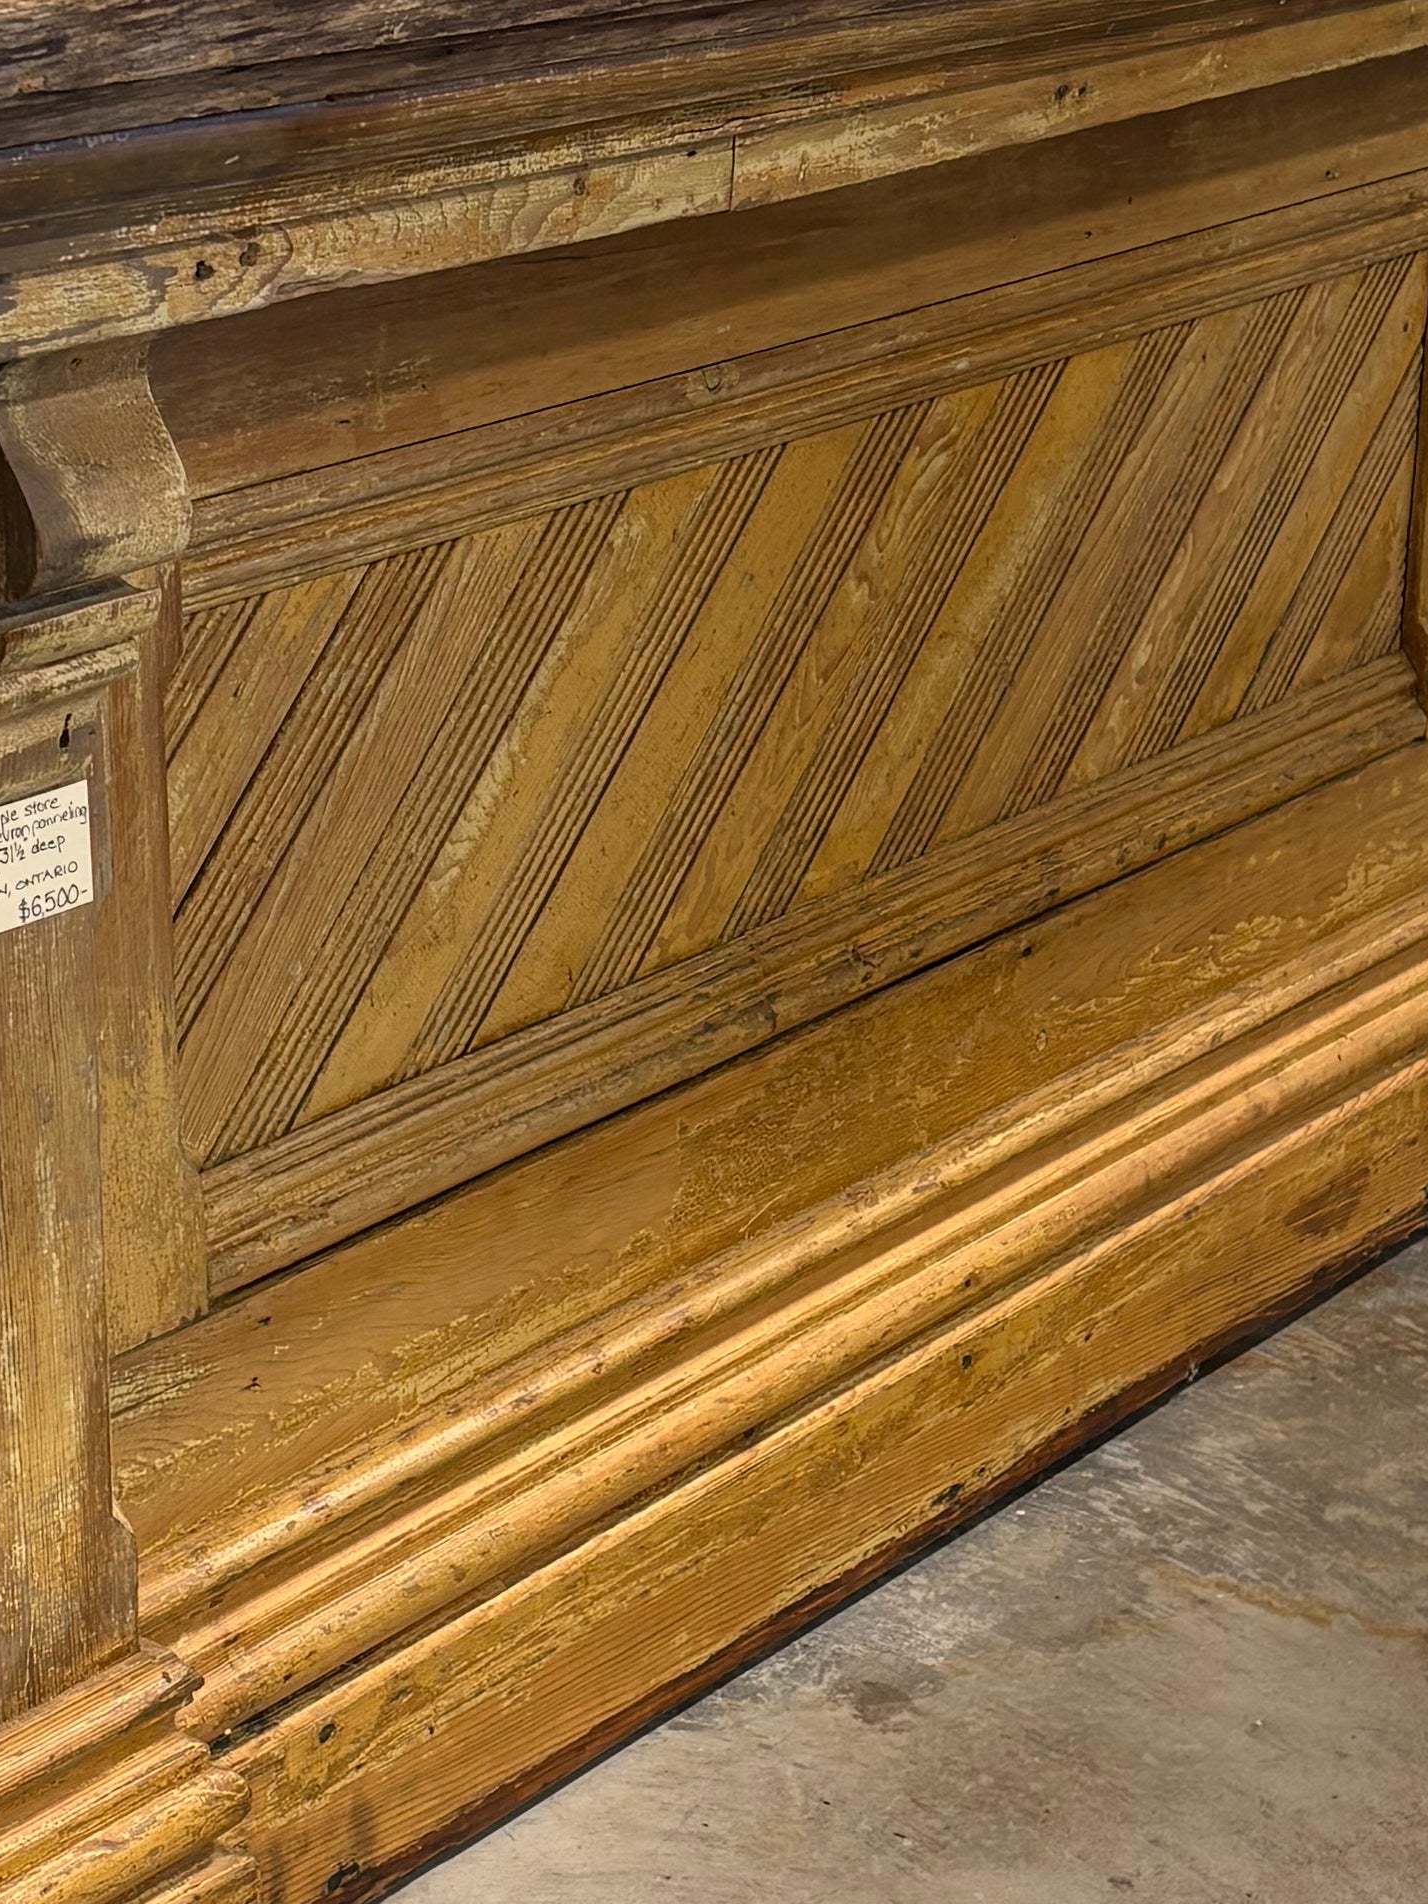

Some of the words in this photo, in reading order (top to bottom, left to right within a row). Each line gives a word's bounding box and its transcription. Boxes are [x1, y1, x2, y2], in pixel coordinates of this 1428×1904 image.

[23, 796, 61, 818] store
[31, 834, 67, 856] deep
[15, 860, 79, 892] ONTARIO
